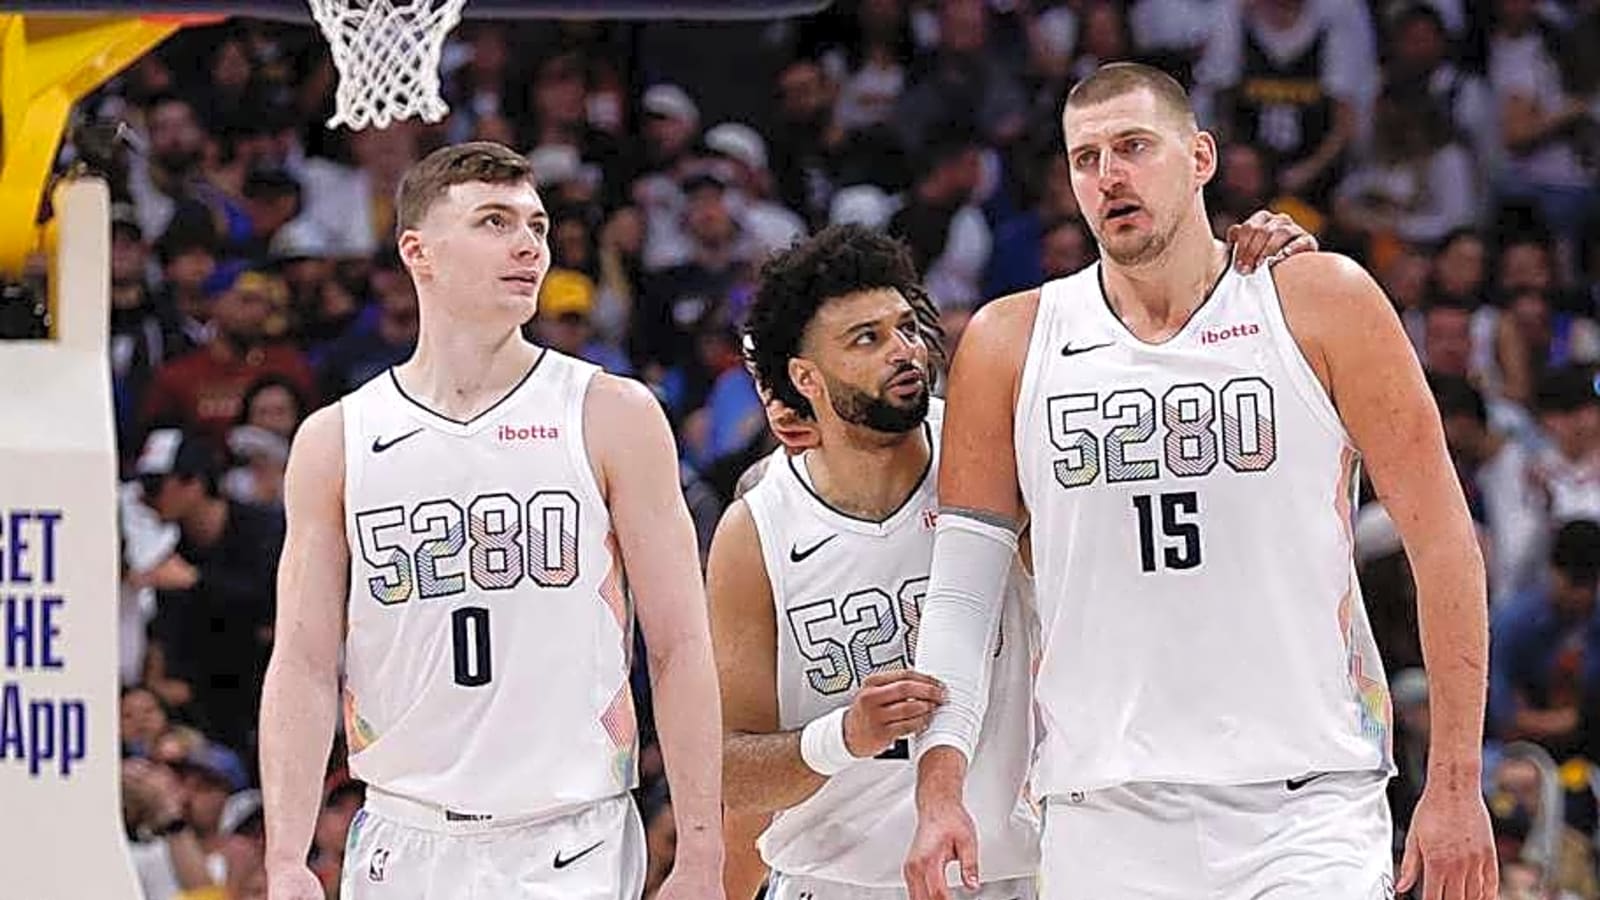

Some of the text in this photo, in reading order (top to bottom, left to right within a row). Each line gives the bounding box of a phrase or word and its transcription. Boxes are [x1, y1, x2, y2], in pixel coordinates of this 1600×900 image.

[1201, 323, 1259, 345] ibotta
[498, 424, 559, 441] ibotta
[1047, 376, 1277, 489] 5280
[0, 510, 63, 584] ET
[355, 490, 580, 605] 5280
[1132, 491, 1202, 572] 15
[0, 597, 65, 668] HE
[451, 606, 492, 687] 0
[0, 684, 86, 776] App
